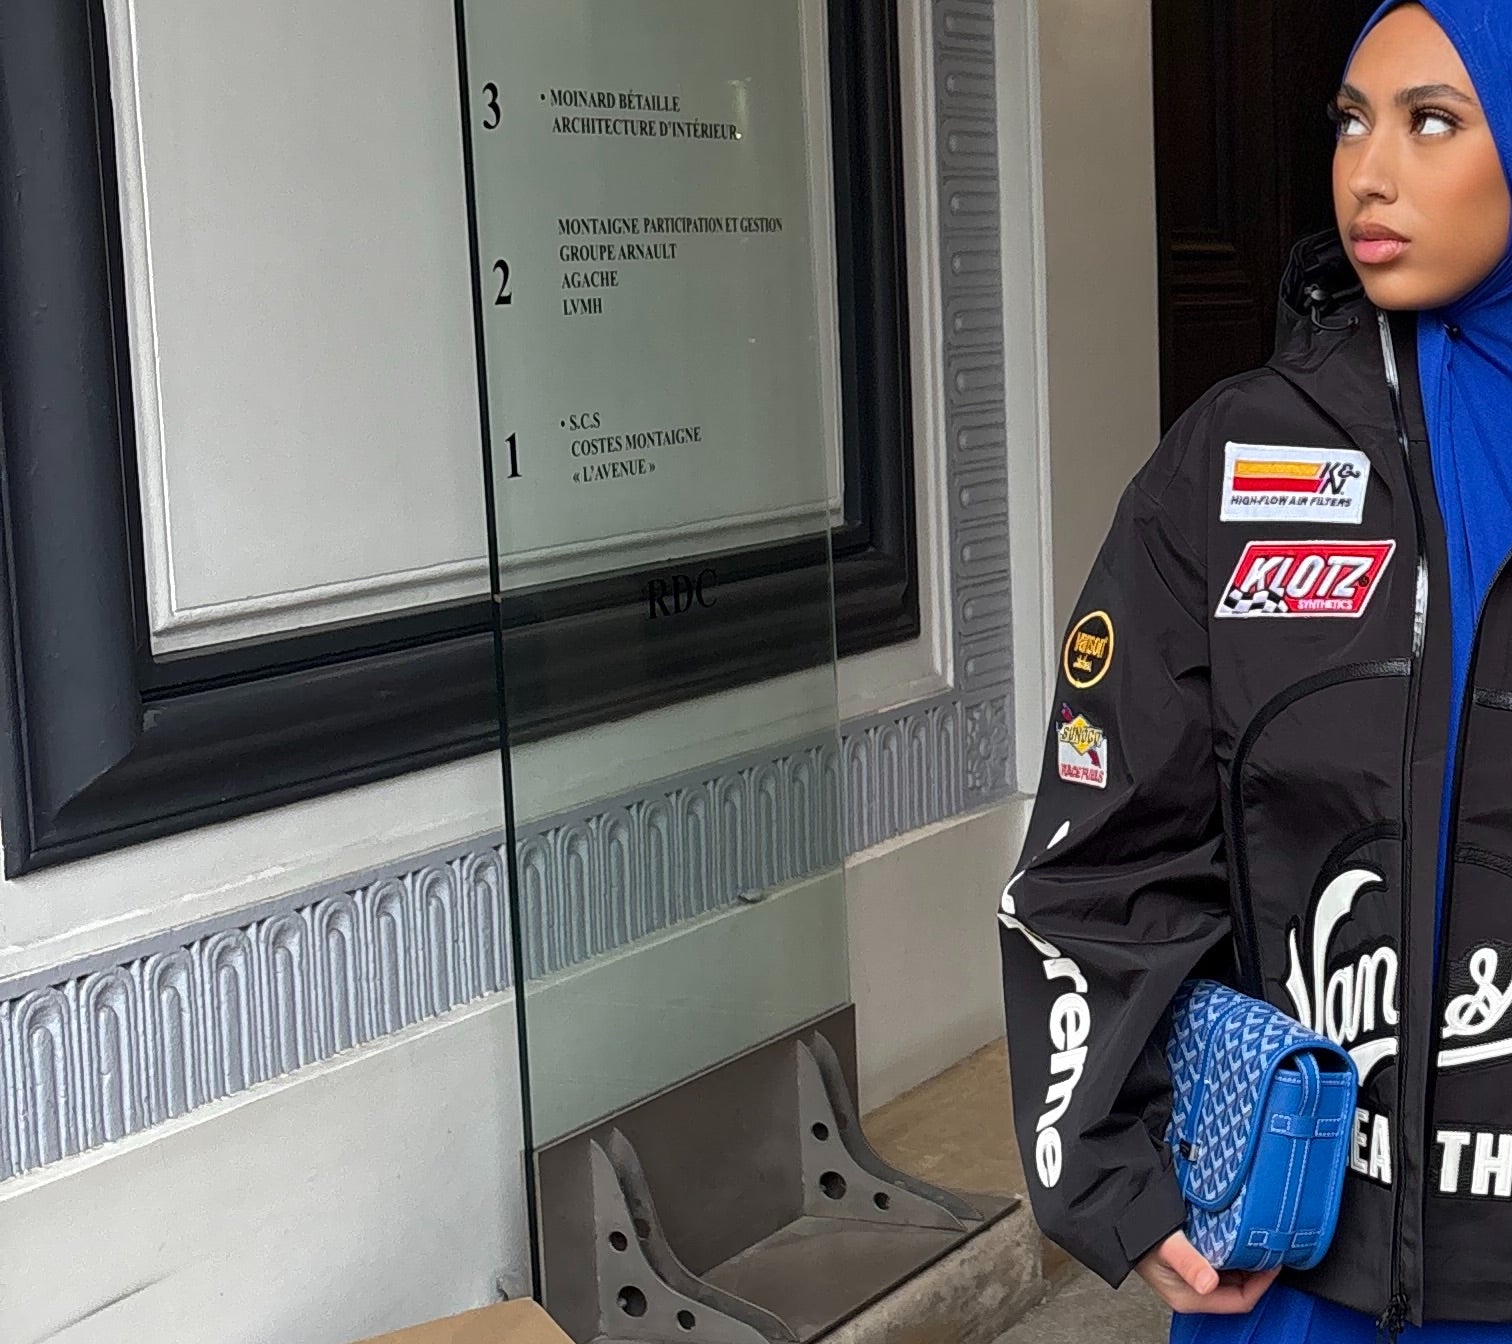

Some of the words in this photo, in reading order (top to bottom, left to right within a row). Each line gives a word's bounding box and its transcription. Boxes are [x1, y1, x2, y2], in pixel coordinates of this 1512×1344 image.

[482, 82, 501, 130] 3
[549, 88, 616, 110] MOINARD
[618, 89, 681, 113] BÉTAILLE
[552, 116, 657, 137] ARCHITECTURE
[659, 117, 738, 141] D'INTÉRIEUR
[557, 217, 640, 236] MONTAIGNE
[643, 216, 724, 234] PARTICIPATION
[725, 217, 738, 234] ET
[739, 216, 783, 233] GESTION
[559, 244, 616, 263] GROUPE
[617, 242, 678, 261] ARNAULT
[492, 259, 513, 306] 2
[561, 270, 619, 290] AGACHE
[562, 297, 603, 316] LVMH
[571, 432, 623, 457] COSTES
[624, 426, 702, 452] MONTAIGNE
[504, 432, 522, 479] 1
[1289, 496, 1308, 506] AIR
[1309, 496, 1352, 508] FILTERS
[1240, 555, 1375, 598] KLOTZ
[648, 568, 718, 619] RDC
[1297, 598, 1353, 611] SYNTHETICS
